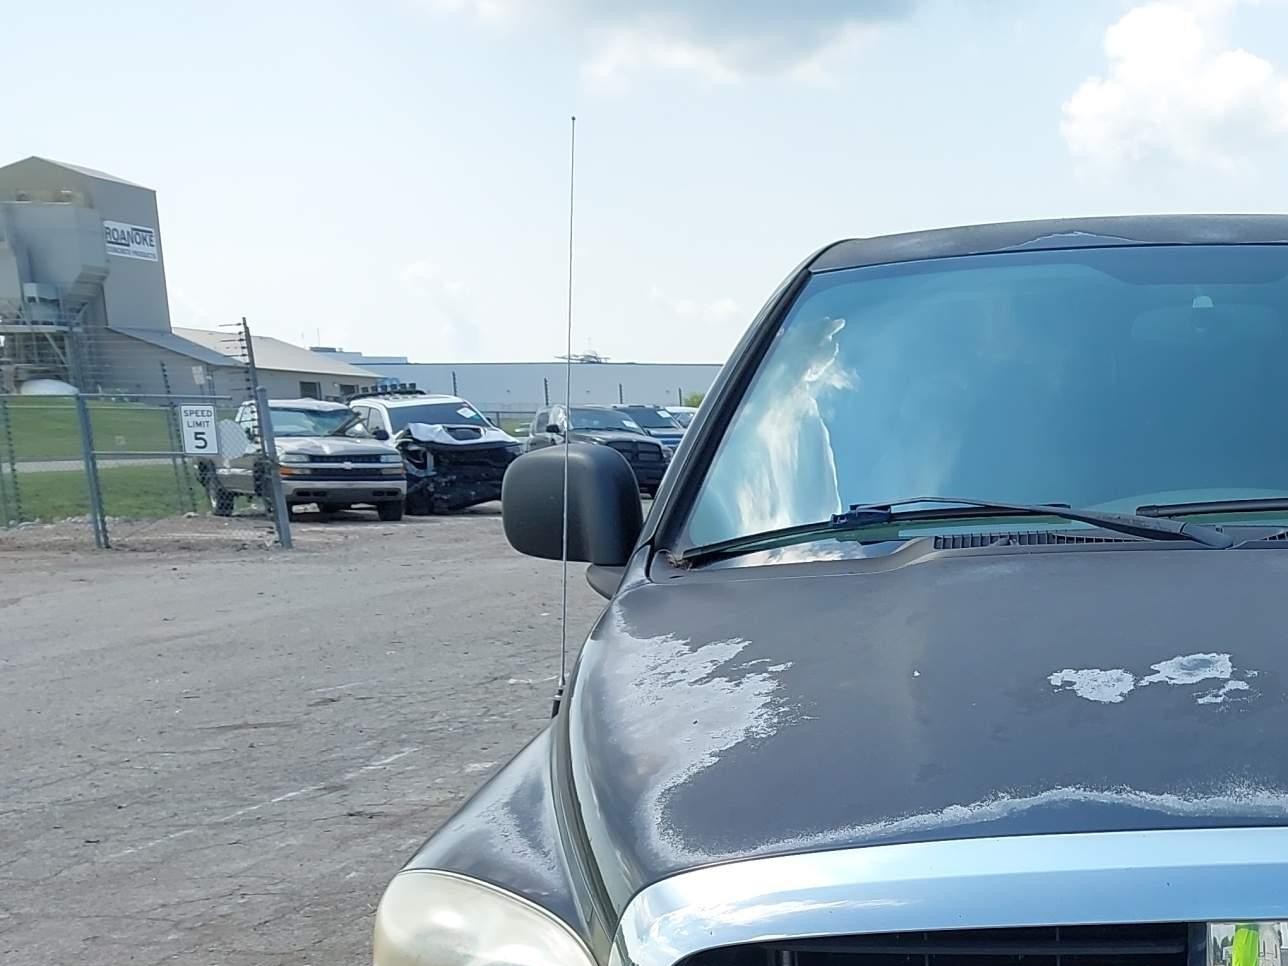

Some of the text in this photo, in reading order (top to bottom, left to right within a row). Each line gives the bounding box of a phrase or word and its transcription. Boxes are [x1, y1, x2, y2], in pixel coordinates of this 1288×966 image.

[104, 226, 155, 248] ROANOKE
[183, 409, 213, 418] SPEED
[186, 420, 210, 428] LIMIT
[193, 431, 208, 450] 5
